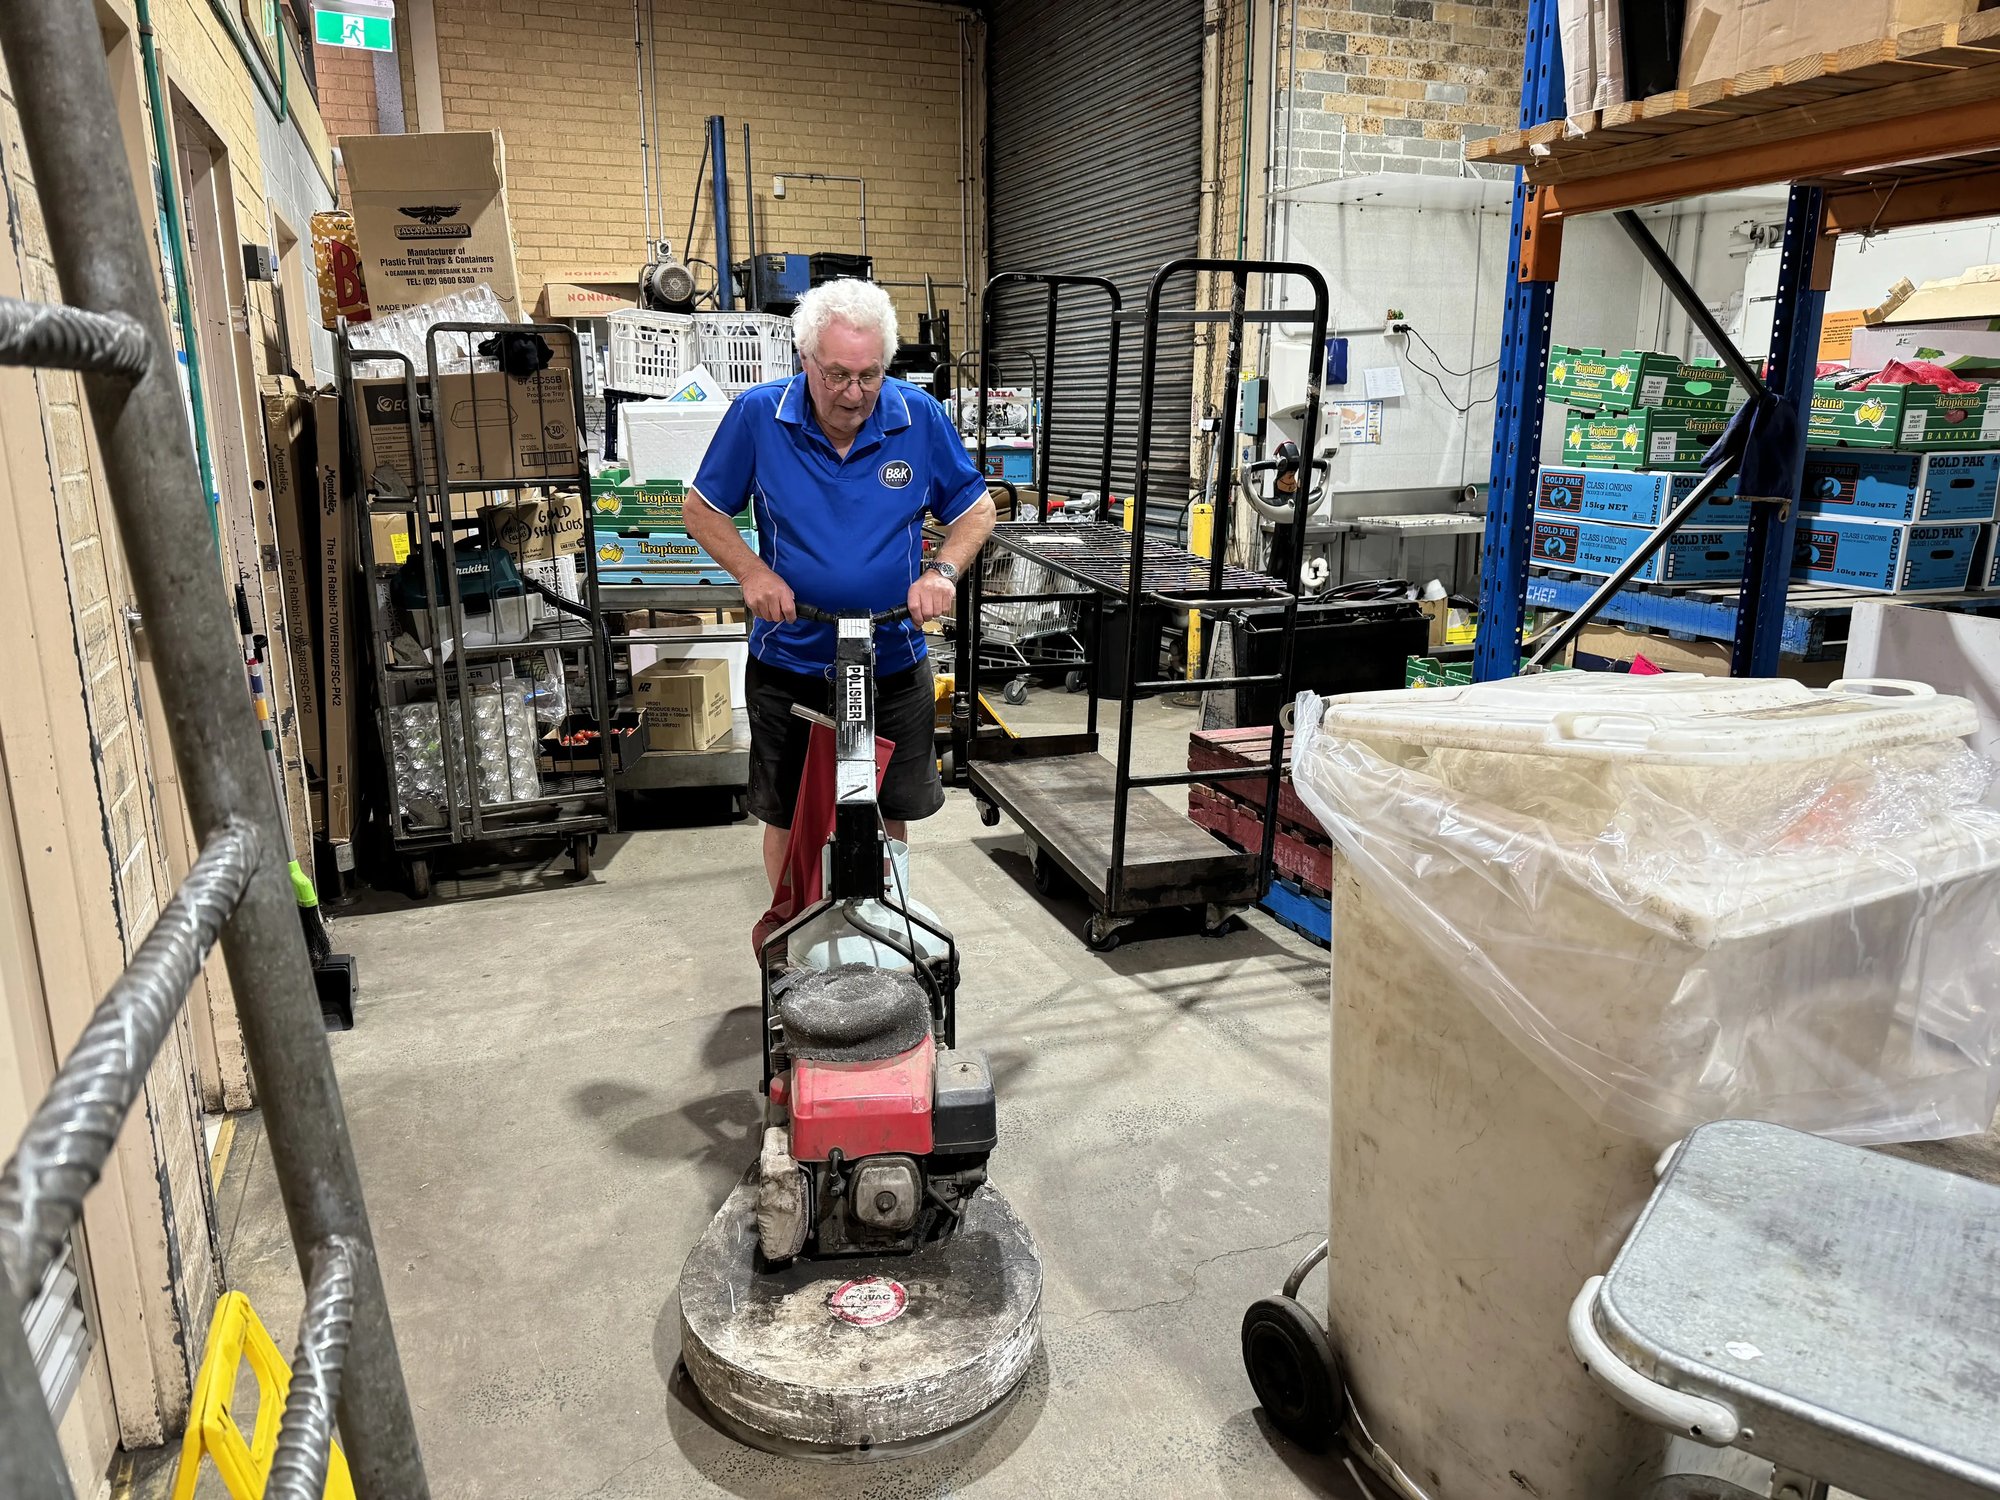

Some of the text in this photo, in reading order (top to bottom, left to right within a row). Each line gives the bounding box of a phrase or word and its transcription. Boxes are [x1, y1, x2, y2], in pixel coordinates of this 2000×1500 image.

[407, 247, 466, 257] Manufacturer of
[380, 254, 494, 267] Plastic Fruit Trays & Containers
[406, 278, 421, 286] TEL:
[423, 277, 437, 286] (02)
[458, 275, 475, 284] 6300
[567, 292, 623, 302] NONNA'S
[1573, 359, 1606, 377] Tropicana
[1677, 364, 1726, 380] Tropicana
[1666, 399, 1720, 410] BANANA
[1935, 395, 1980, 409] Tropicana
[551, 425, 561, 434] 30
[1588, 422, 1618, 439] Tropicana
[1926, 431, 1977, 440] BANANA
[1929, 456, 1986, 468] GOLD PAK
[886, 466, 908, 479] B&K
[1909, 458, 1920, 490] GOLD
[1544, 475, 1581, 485] GOLD PAK
[1586, 481, 1605, 490] CLASS
[1610, 483, 1633, 492] ONIONS
[1653, 477, 1662, 502] GOLD
[1585, 501, 1629, 511] 15kg NET
[1856, 500, 1876, 508] 10kg
[1903, 494, 1914, 519] PAK
[1650, 504, 1659, 524] PAK
[1537, 525, 1575, 536] GOLD PAK
[1910, 528, 1964, 539] GOLD PAK
[1581, 532, 1600, 543] CLASS
[1605, 535, 1628, 546] ONIONS
[1670, 534, 1724, 544] GOLD PAK
[1811, 533, 1833, 544] PAK
[1864, 533, 1887, 542] ONIONS
[638, 541, 700, 557] Tropicana
[1889, 528, 1901, 561] GOLD
[1579, 552, 1623, 565] 15kg NET
[1645, 559, 1654, 578] PAK
[1836, 568, 1879, 578] 10kg NET
[287, 569, 297, 584] Fat
[1884, 563, 1896, 589] PAK
[1526, 585, 1557, 603] CHEP
[326, 537, 342, 707] The Fat Rabbit-TOWER802FSC-PK2
[848, 666, 862, 720] POLISHER
